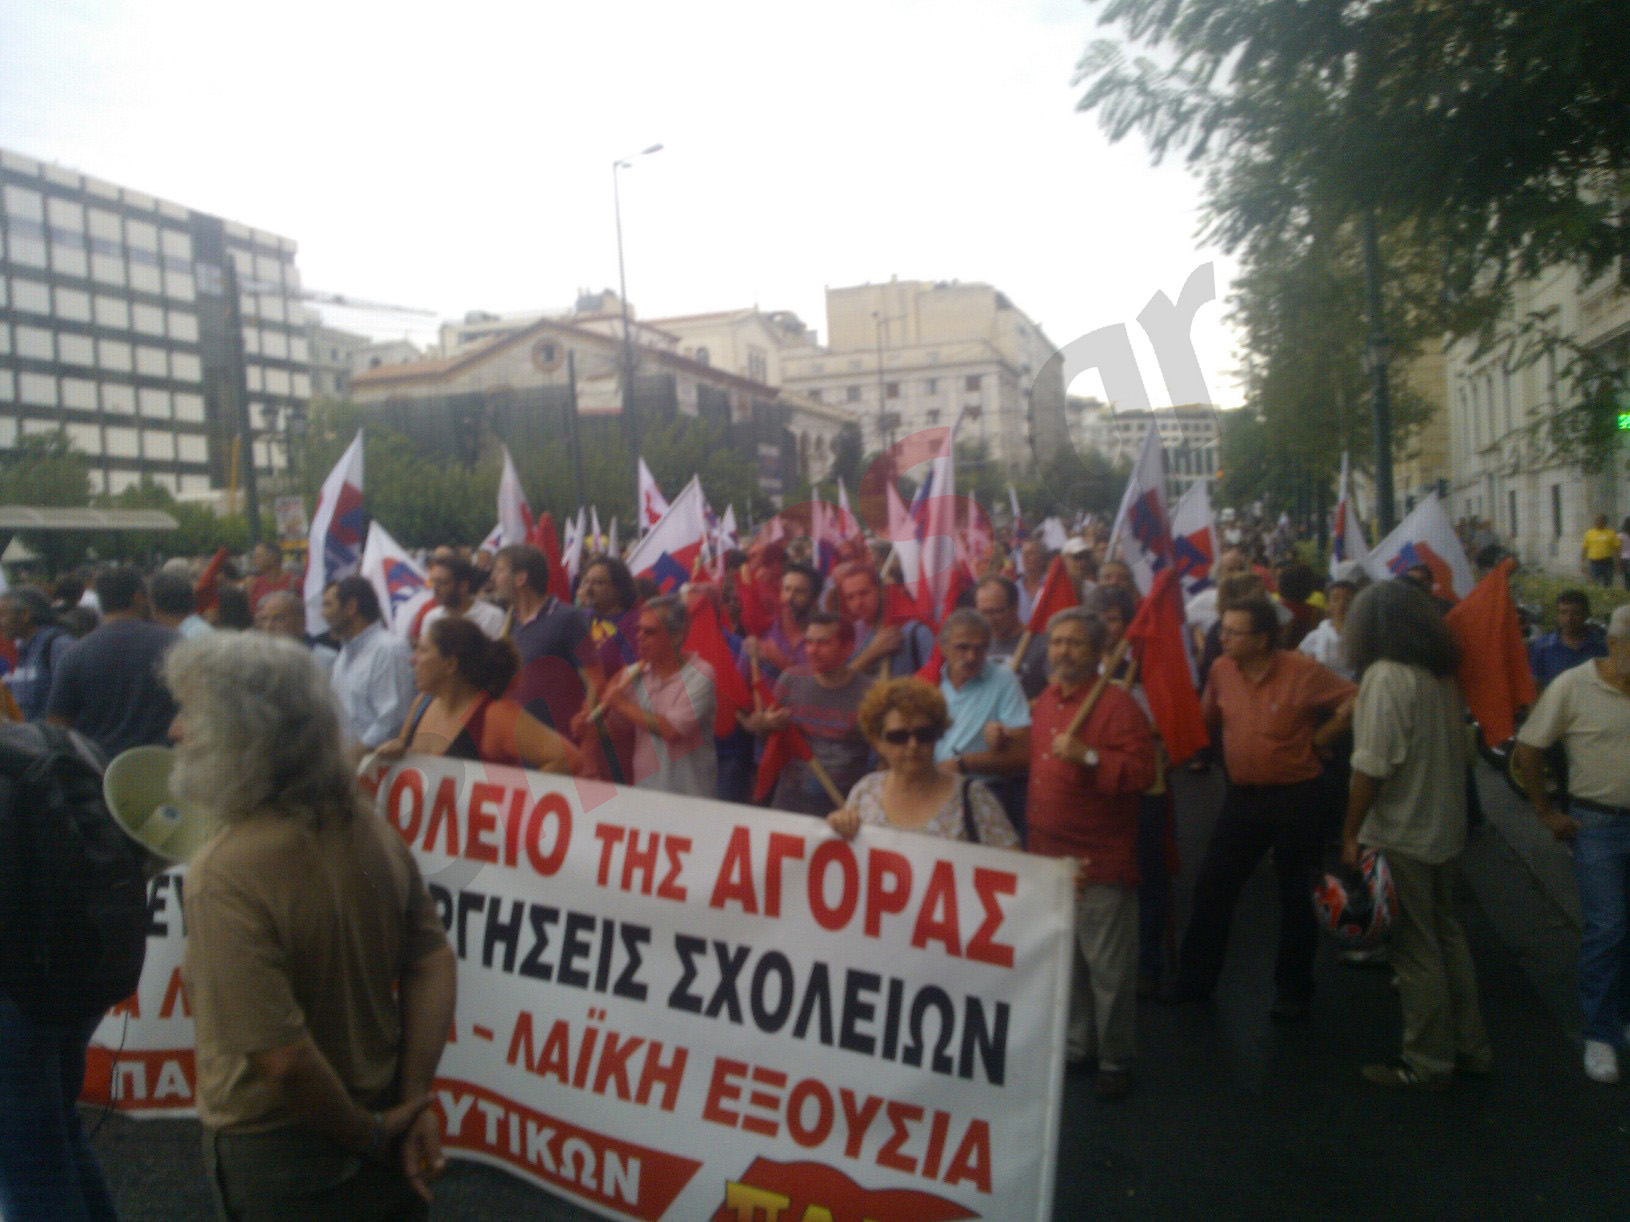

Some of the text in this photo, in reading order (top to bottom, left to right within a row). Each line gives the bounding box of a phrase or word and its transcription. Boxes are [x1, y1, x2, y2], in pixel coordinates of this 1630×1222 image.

[595, 822, 692, 903] ΤΗΣ
[709, 825, 1018, 969] ΑΓΟΡΑΣ
[667, 932, 1010, 1088] ΣΧΟΛΕΙΩΝ
[437, 1090, 642, 1206] ΥΤΙΚΩΝ
[506, 1005, 690, 1113] ΛΑΪΚΗ
[701, 1055, 993, 1196] ΕΞΟΥΣΙΑ
